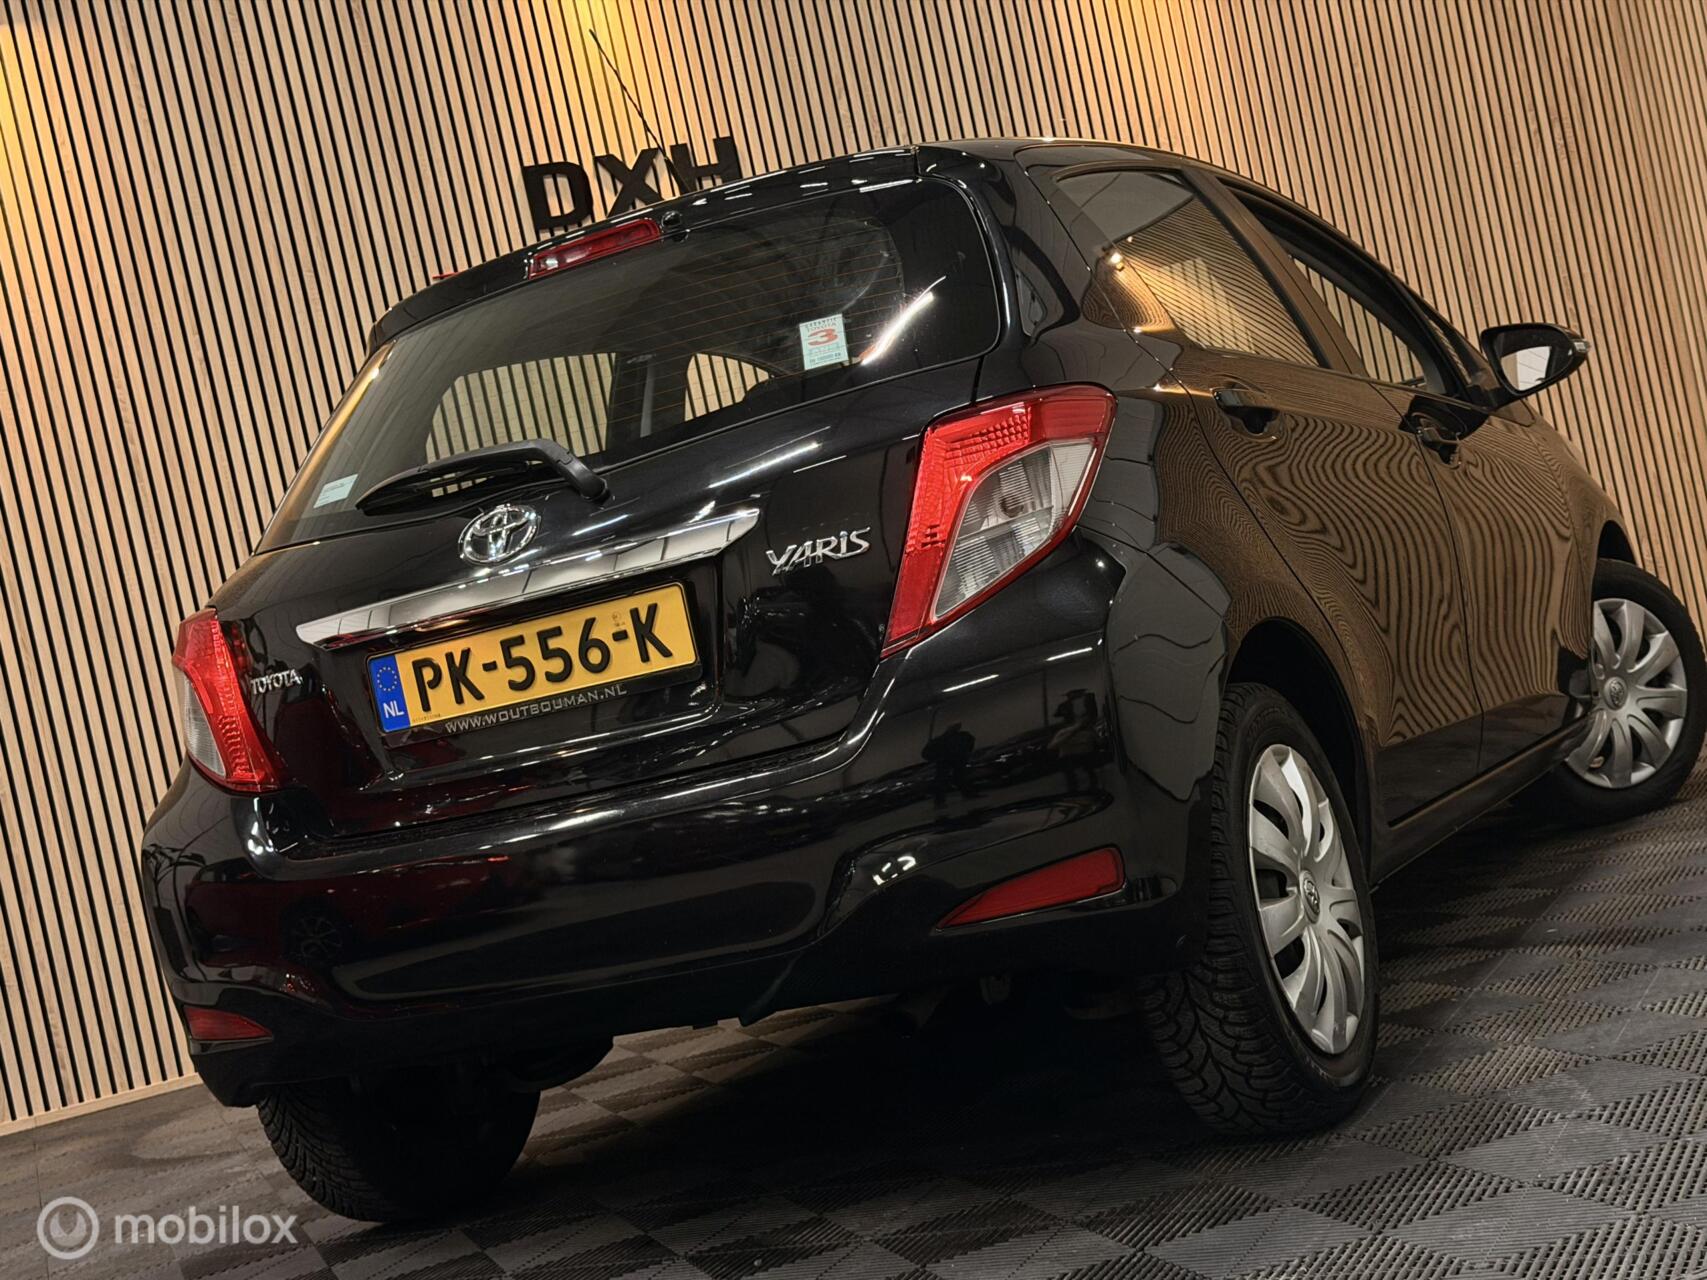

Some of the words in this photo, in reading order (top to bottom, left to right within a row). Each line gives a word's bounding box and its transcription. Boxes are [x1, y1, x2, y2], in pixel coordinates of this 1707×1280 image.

[523, 136, 743, 231] DXH
[250, 668, 302, 695] TOYOTA
[411, 602, 673, 712] PK-556-K
[383, 701, 405, 719] NL
[444, 683, 627, 733] WWW.WOUTBOUMAN.NL
